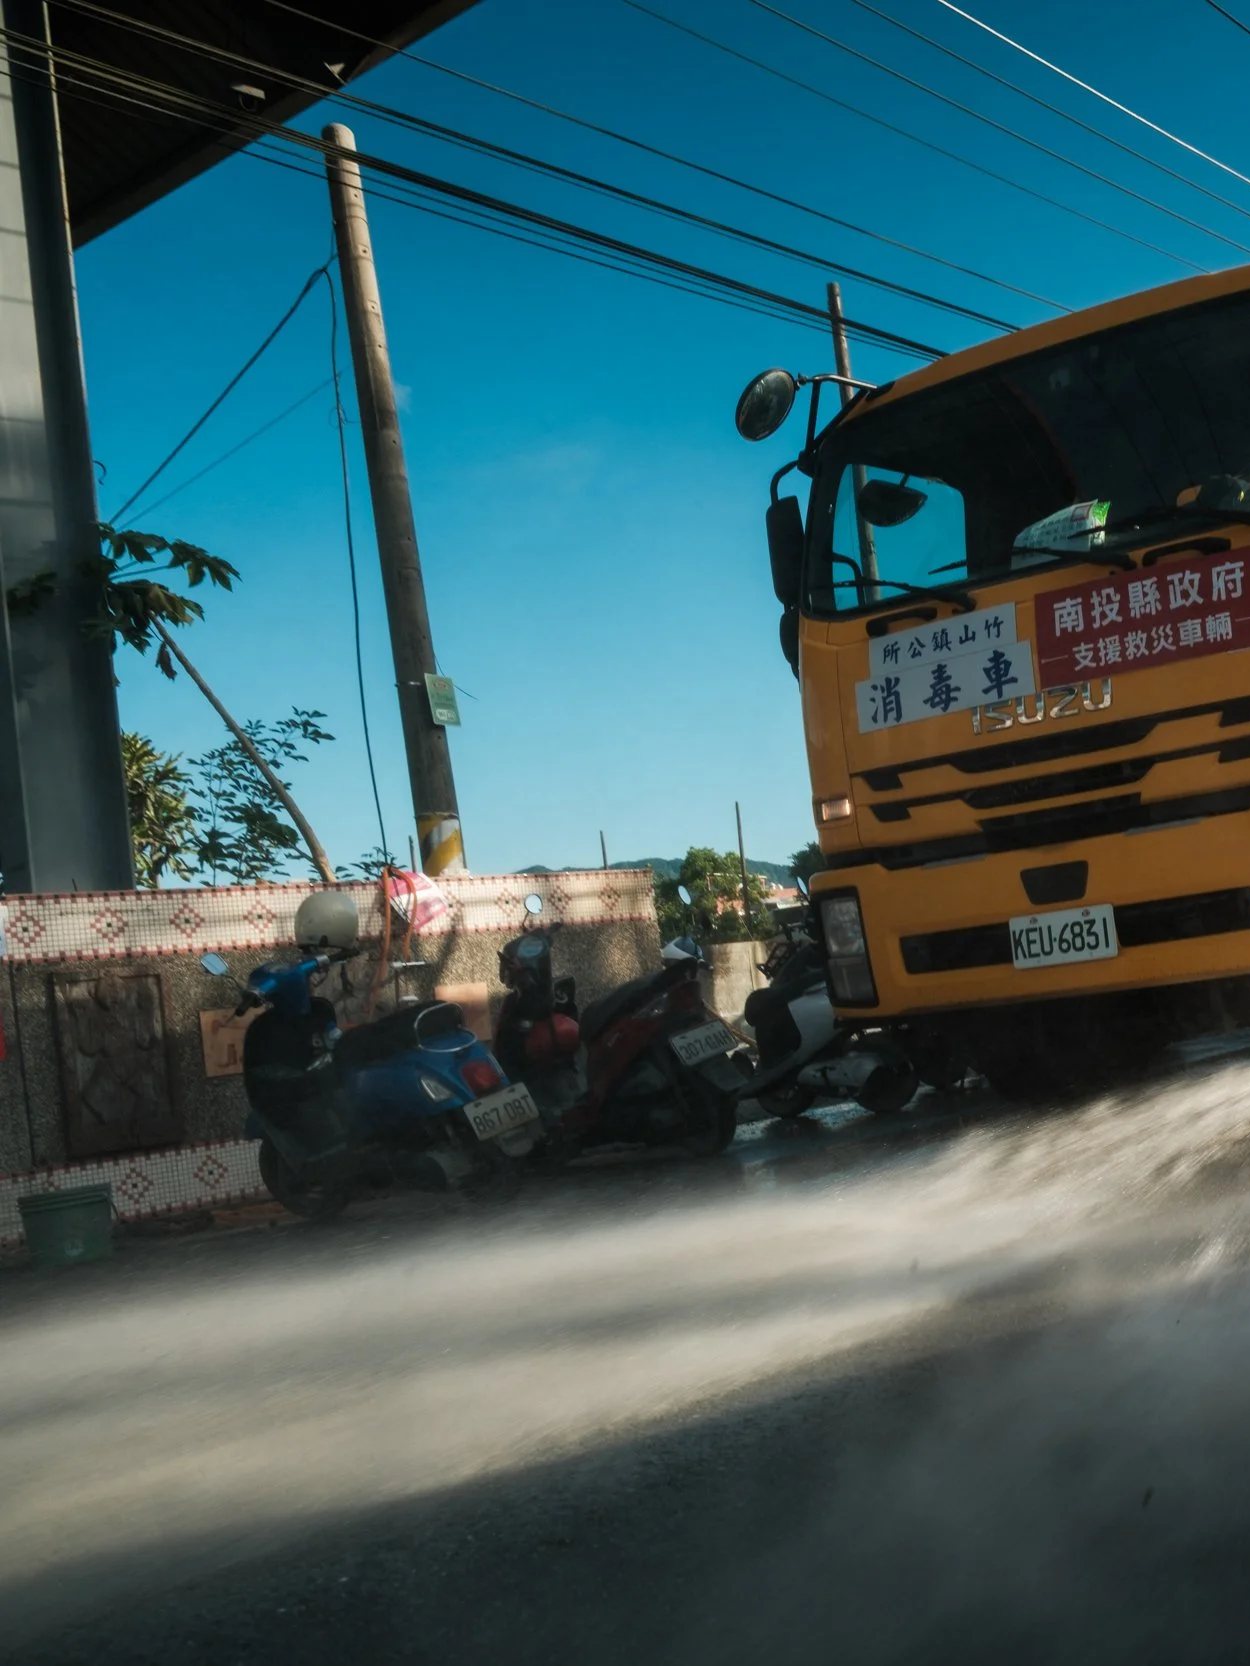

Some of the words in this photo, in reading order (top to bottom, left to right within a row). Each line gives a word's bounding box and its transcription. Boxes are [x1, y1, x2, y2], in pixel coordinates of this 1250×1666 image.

[1052, 560, 1246, 638] 南投縣政府
[1072, 612, 1233, 672] 支援救災車輛
[869, 650, 1019, 725] 消毒車
[971, 678, 1114, 736] ISUZU
